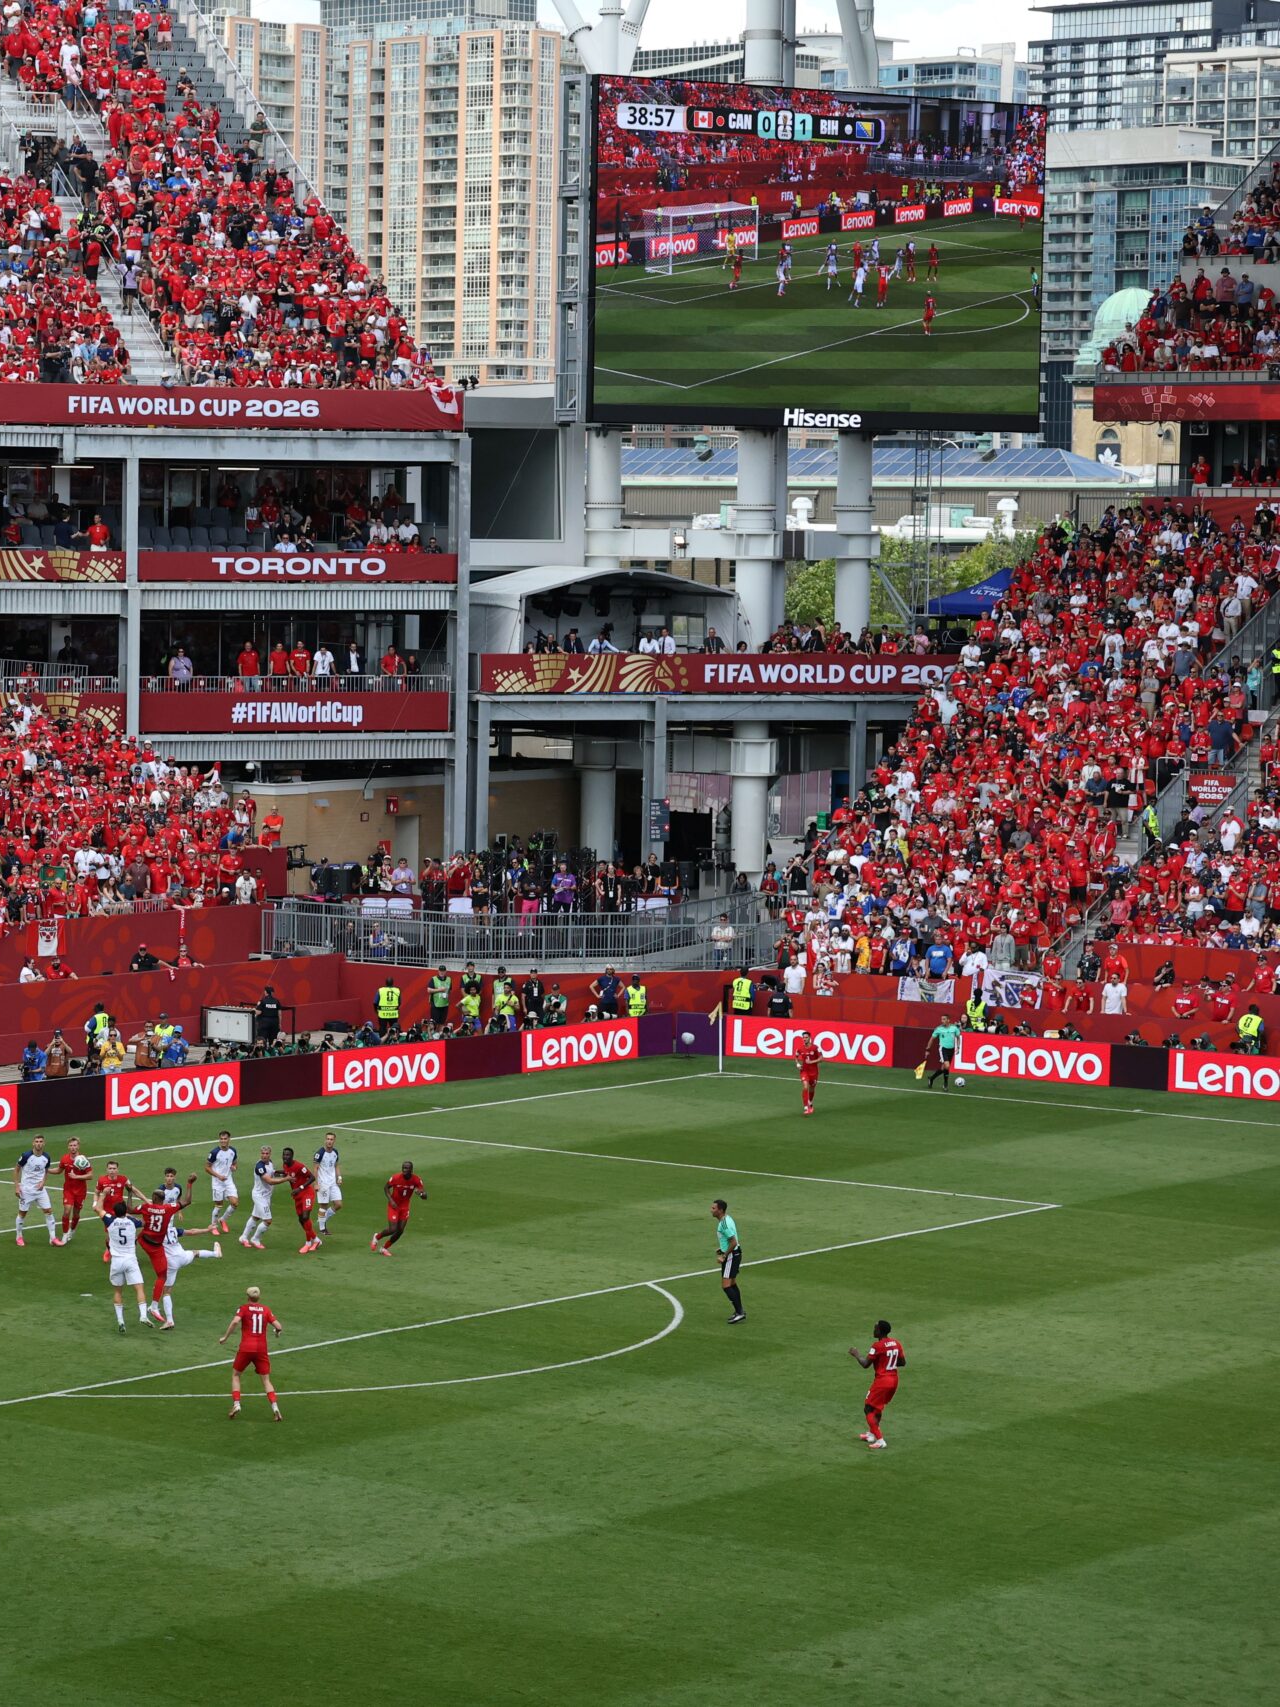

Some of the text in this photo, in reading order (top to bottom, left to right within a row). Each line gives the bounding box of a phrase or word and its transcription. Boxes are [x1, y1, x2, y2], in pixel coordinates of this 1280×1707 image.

[627, 106, 675, 127] 38:57
[728, 113, 772, 133] CAN 0
[800, 118, 839, 136] 1 BIH
[781, 191, 794, 201] FIFA
[896, 207, 924, 223] Lenovo
[944, 202, 971, 216] Lenovo
[783, 217, 819, 237] Lenovo
[841, 214, 874, 230] Lenovo
[68, 396, 320, 418] FIFA WORLD CUP 2026
[783, 408, 862, 429] Hisense
[211, 557, 386, 576] TORONTO
[704, 664, 956, 684] FIFA WORLD CUP 20
[231, 700, 363, 726] #FIFAWorldCup
[526, 1029, 633, 1068] Lenovo
[733, 1019, 886, 1063] Lenovo
[954, 1036, 1103, 1081] Lenovo
[327, 1053, 440, 1091] Lenovo
[1175, 1052, 1280, 1097] Leno
[111, 1075, 234, 1115] Lenovo
[149, 1215, 163, 1232] 13
[119, 1228, 127, 1245] 5
[252, 1313, 263, 1334] 11
[886, 1348, 899, 1371] 22
